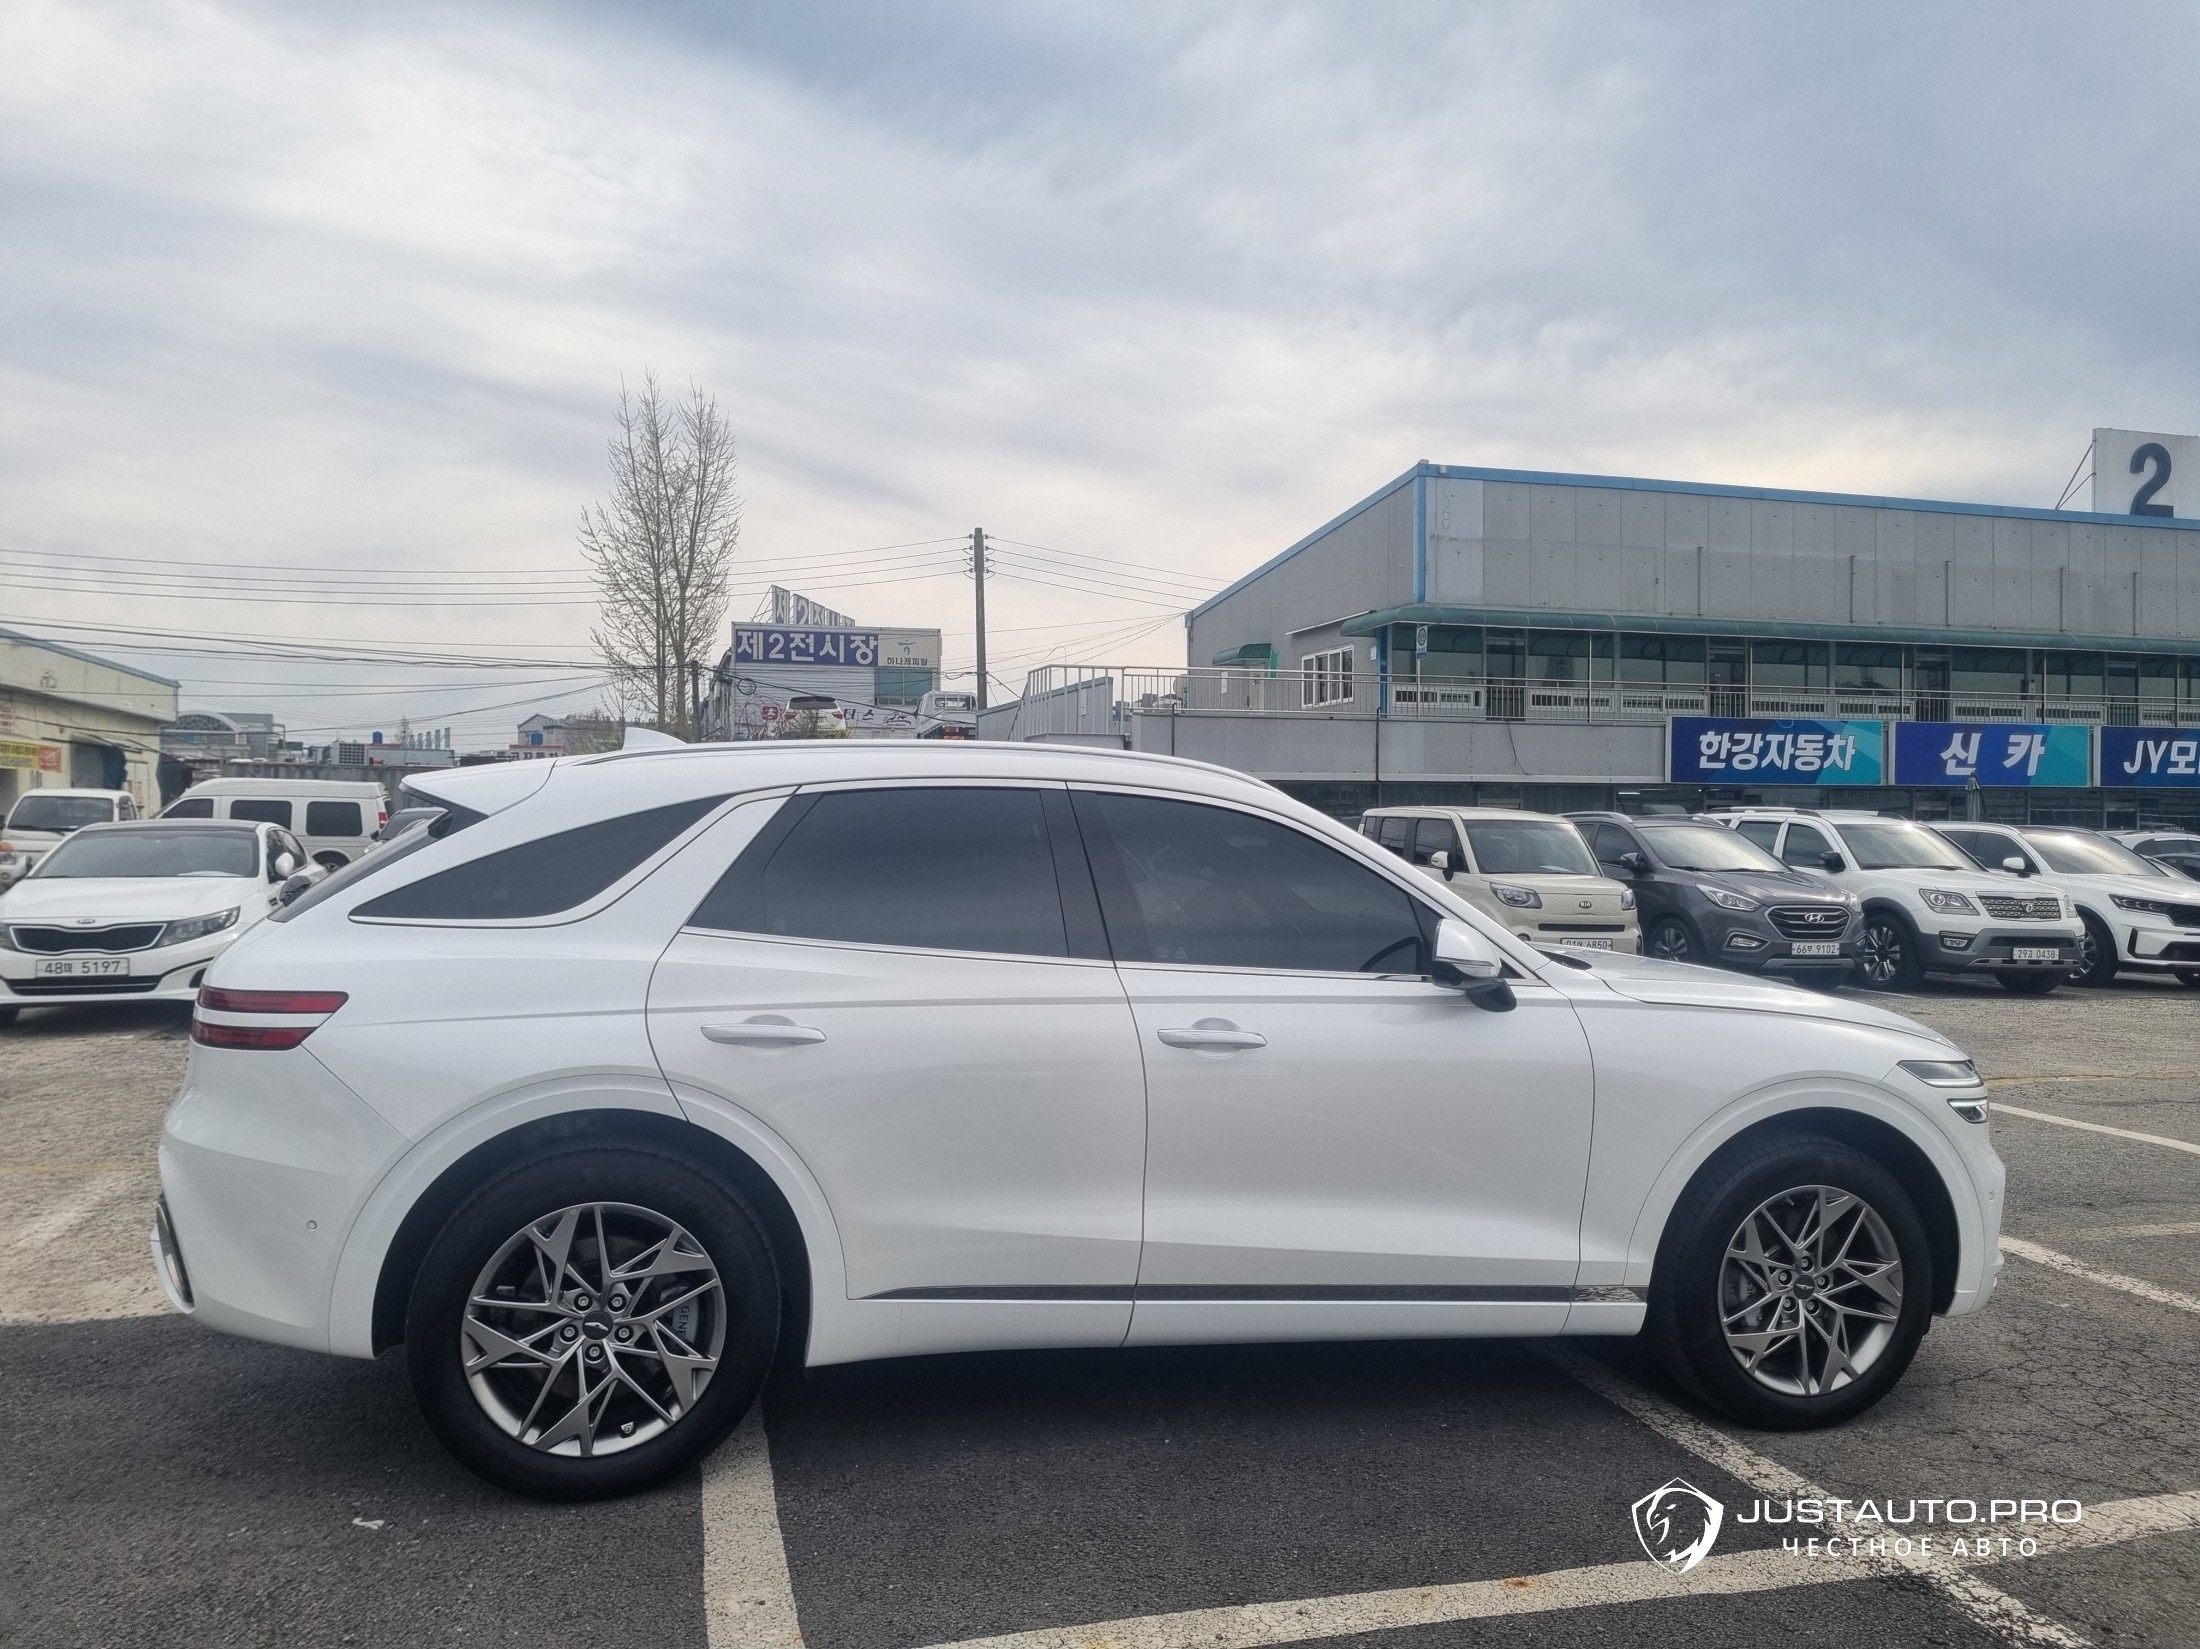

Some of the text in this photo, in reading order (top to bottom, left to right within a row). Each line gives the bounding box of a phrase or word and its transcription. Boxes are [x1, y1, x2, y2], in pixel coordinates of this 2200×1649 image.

[2129, 442, 2174, 518] 2
[737, 629, 879, 666] 제2전시장
[1698, 730, 1857, 772] 한강자동차
[2123, 740, 2200, 775] JY모
[1816, 944, 1836, 954] 9102
[2036, 949, 2056, 959] 0438
[81, 960, 121, 974] 5197
